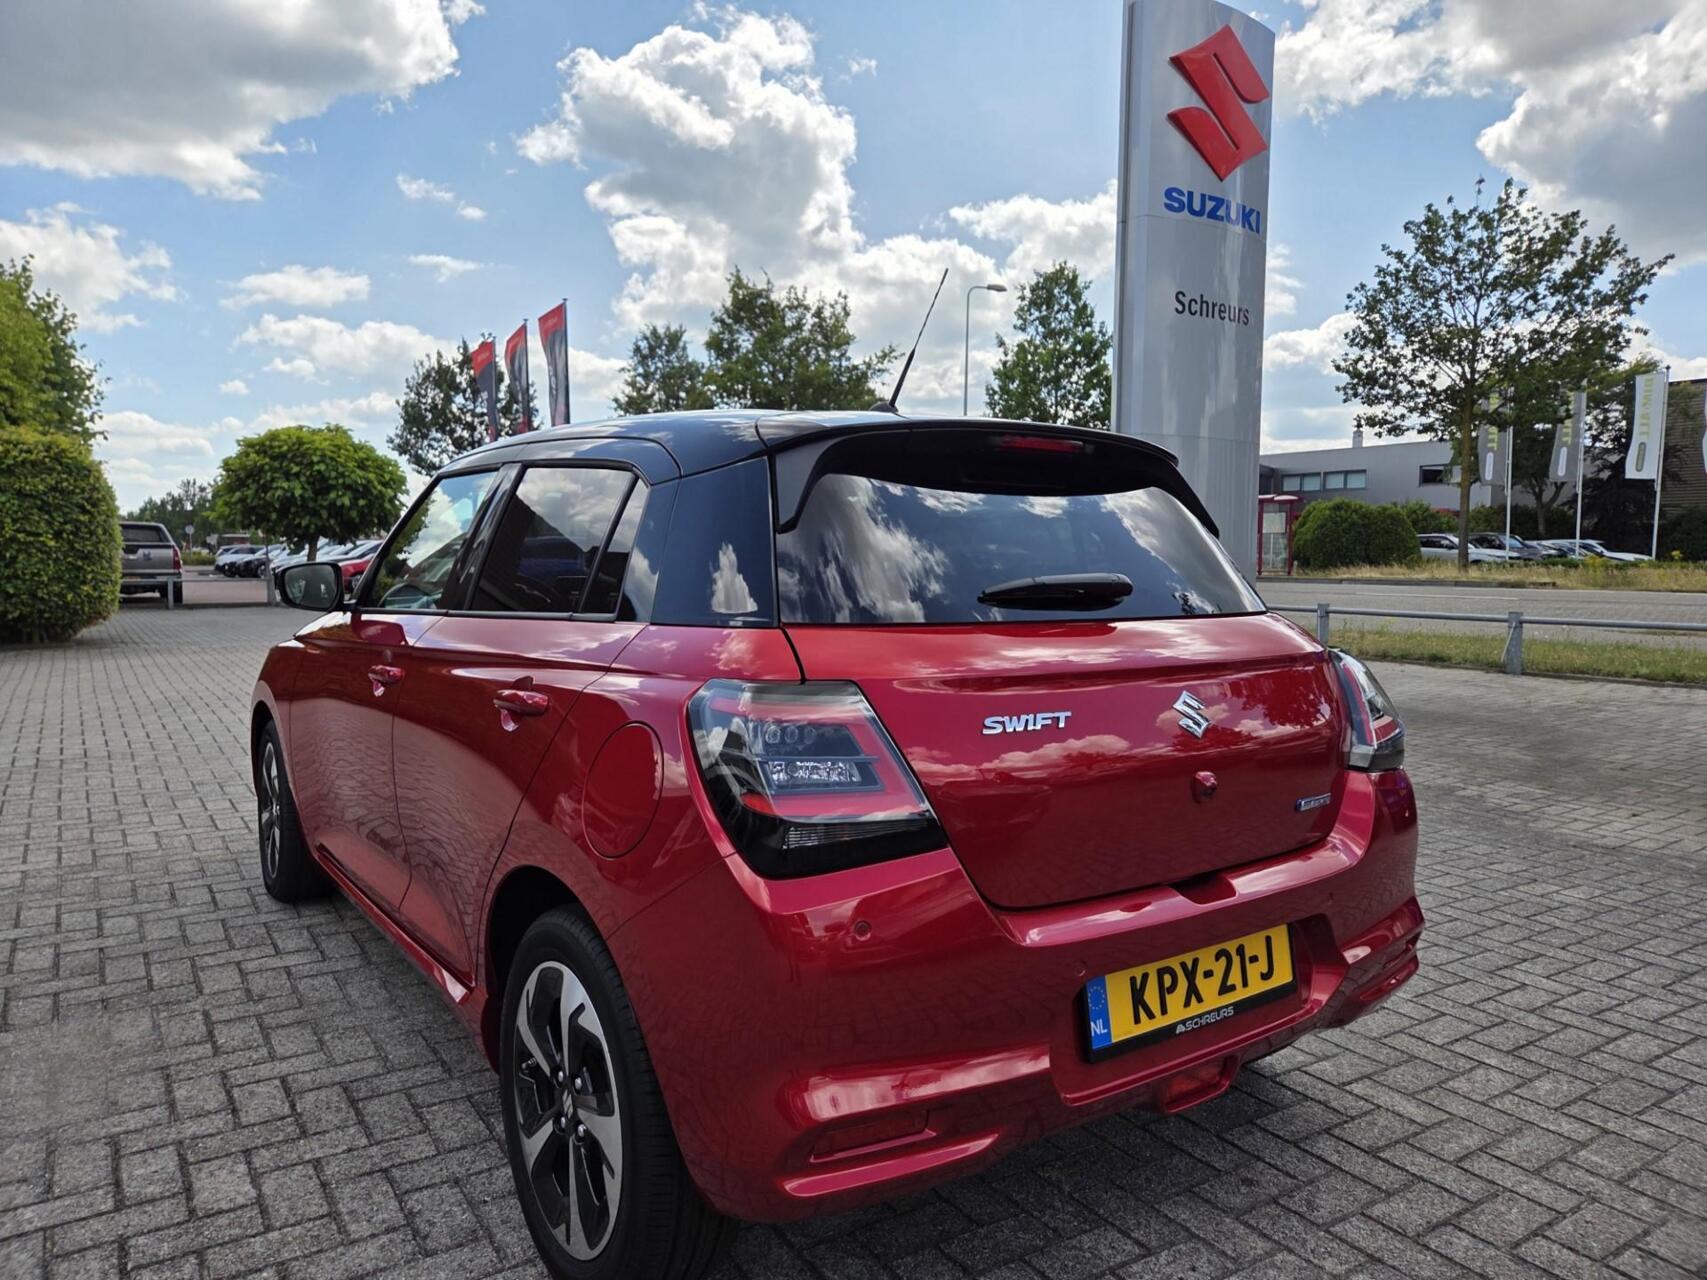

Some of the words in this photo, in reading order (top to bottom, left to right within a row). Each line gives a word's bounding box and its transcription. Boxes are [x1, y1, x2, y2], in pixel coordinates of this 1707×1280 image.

[1163, 187, 1261, 234] SUZUKI
[1174, 290, 1250, 327] Schreurs
[982, 711, 1071, 735] SWIFT
[1129, 935, 1275, 1025] KPX-21-J
[1090, 1018, 1108, 1037] NL
[1185, 1006, 1234, 1032] SCHREURS
